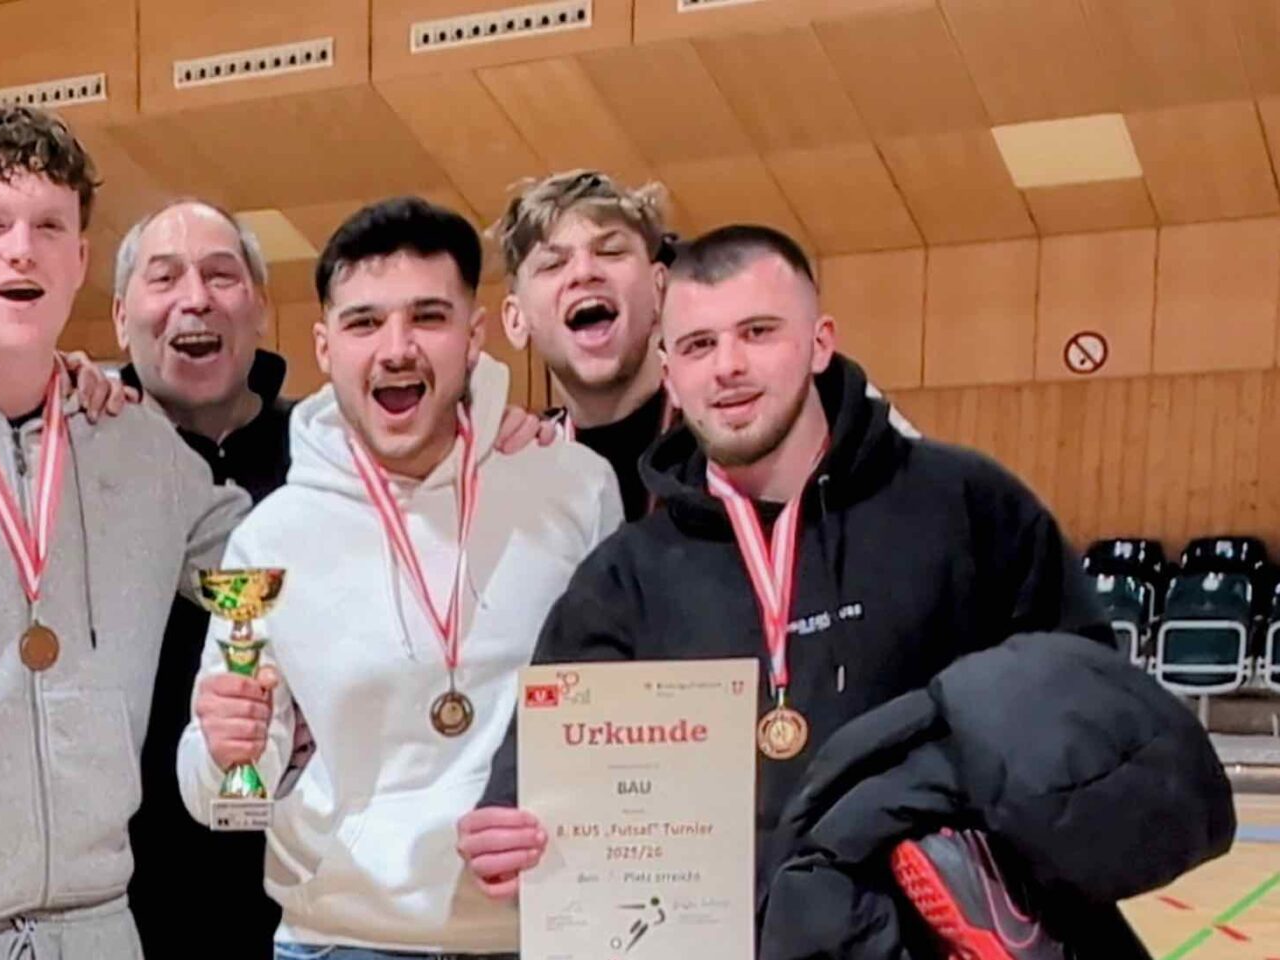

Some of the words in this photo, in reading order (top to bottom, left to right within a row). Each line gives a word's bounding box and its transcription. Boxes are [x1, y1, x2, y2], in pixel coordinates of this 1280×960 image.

[563, 719, 708, 746] Urkunde
[617, 780, 652, 795] BAU
[573, 824, 600, 837] KUS
[663, 822, 714, 837] Turnier
